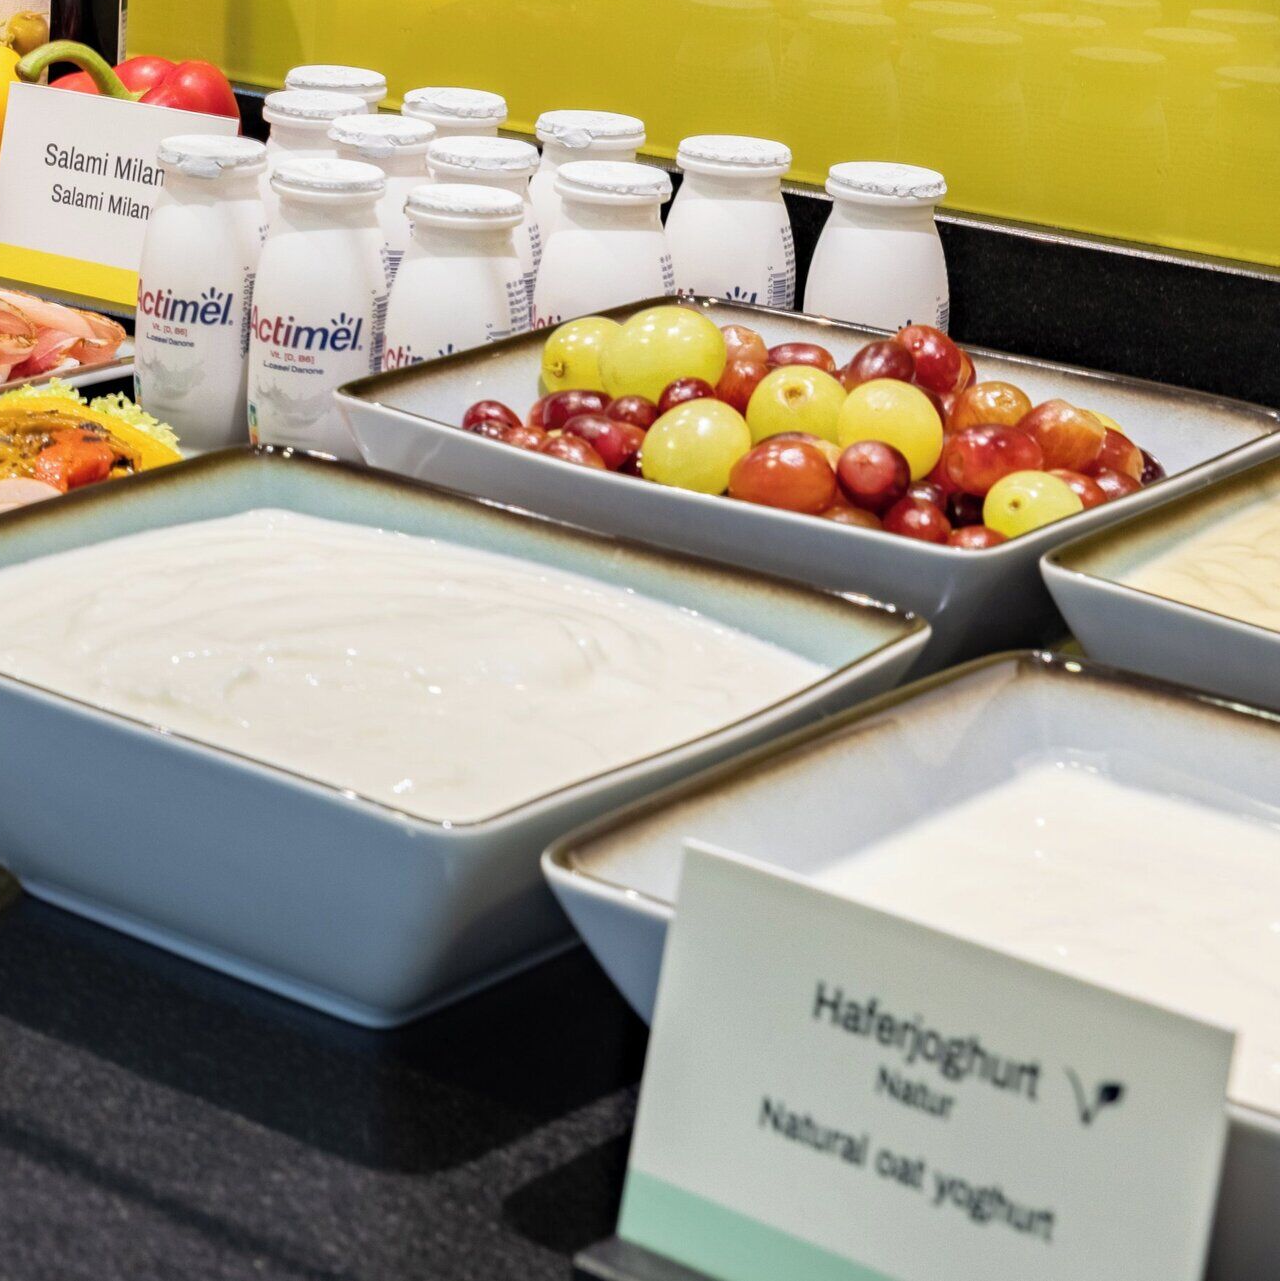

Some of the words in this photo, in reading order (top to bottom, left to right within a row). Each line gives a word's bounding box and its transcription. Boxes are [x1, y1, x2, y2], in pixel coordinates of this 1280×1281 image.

[44, 143, 109, 176] Salami
[114, 155, 165, 187] Milan
[51, 183, 104, 211] Salami
[107, 194, 153, 221] Milan
[137, 278, 234, 326] Actimel
[168, 338, 195, 348] Danone
[250, 305, 363, 352] Actimel
[291, 365, 324, 375] Danone
[812, 980, 1042, 1102] Haferjoghurt
[875, 1066, 956, 1121] Natur
[758, 1095, 868, 1167] Natural
[874, 1146, 925, 1189] oat
[933, 1167, 1055, 1243] yoghurt
